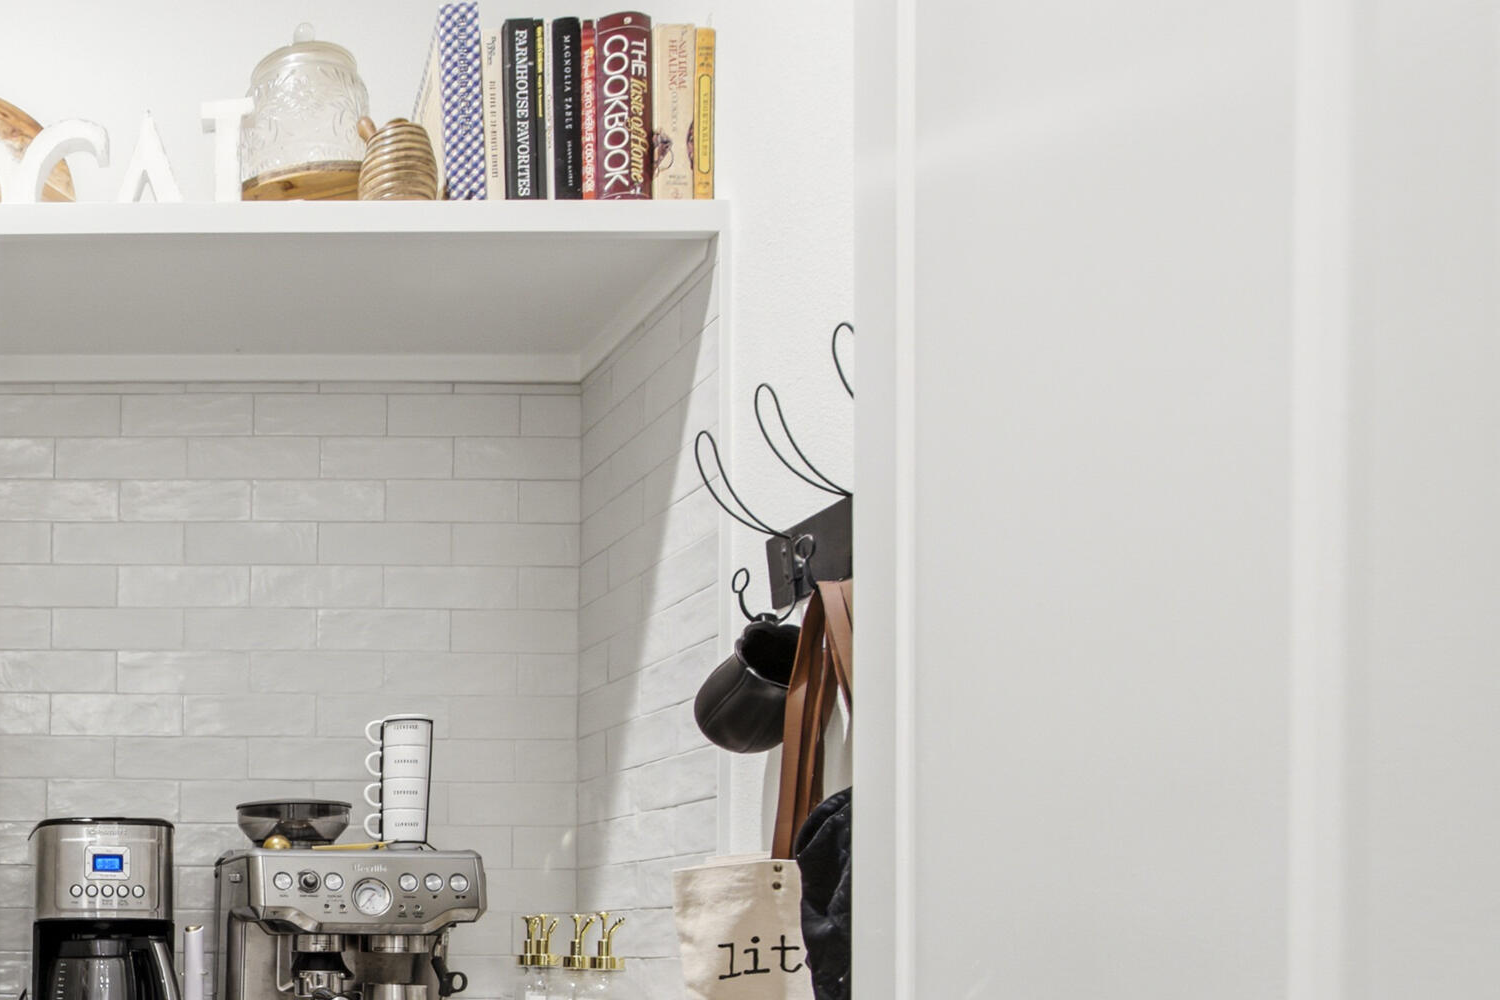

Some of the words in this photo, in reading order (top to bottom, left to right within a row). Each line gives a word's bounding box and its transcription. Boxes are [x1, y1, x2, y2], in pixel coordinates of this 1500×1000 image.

[514, 29, 529, 118] FARMHOUSE
[562, 34, 572, 93] MAGNOLIA
[631, 37, 648, 77] THE
[667, 40, 678, 91] HEALING
[563, 97, 573, 130] TABLE
[602, 34, 630, 192] COOKBOOK
[631, 77, 648, 116] Taste
[624, 115, 648, 136] of
[516, 120, 531, 197] FAVORITES
[630, 134, 649, 183] Home
[717, 935, 803, 980] lit
